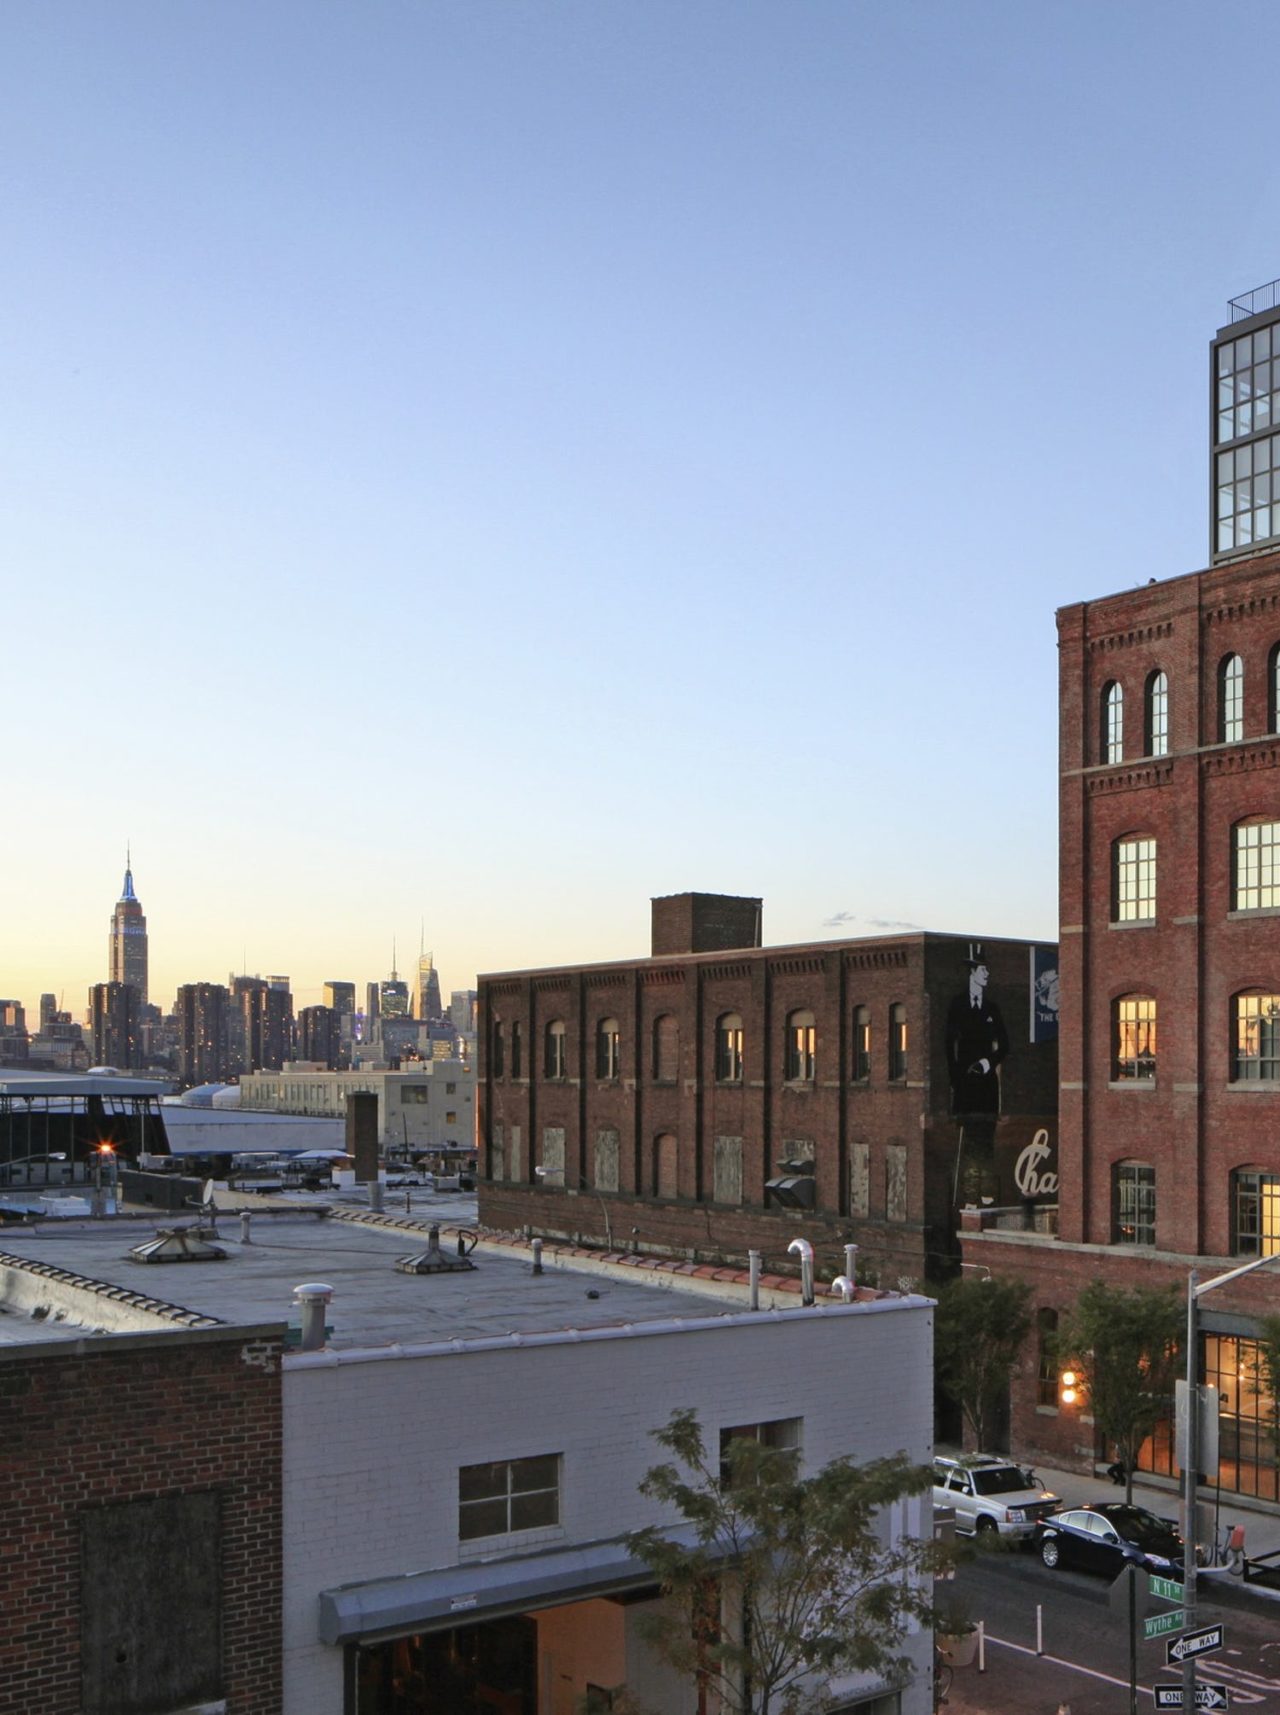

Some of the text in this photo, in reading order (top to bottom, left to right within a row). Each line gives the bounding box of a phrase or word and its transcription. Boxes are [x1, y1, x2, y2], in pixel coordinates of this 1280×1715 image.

[1153, 1579, 1160, 1593] N
[1163, 1582, 1171, 1597] 11
[1145, 1617, 1173, 1636] Wythe
[1175, 1634, 1216, 1655] ONE WAY
[1195, 1692, 1216, 1702] WAY
